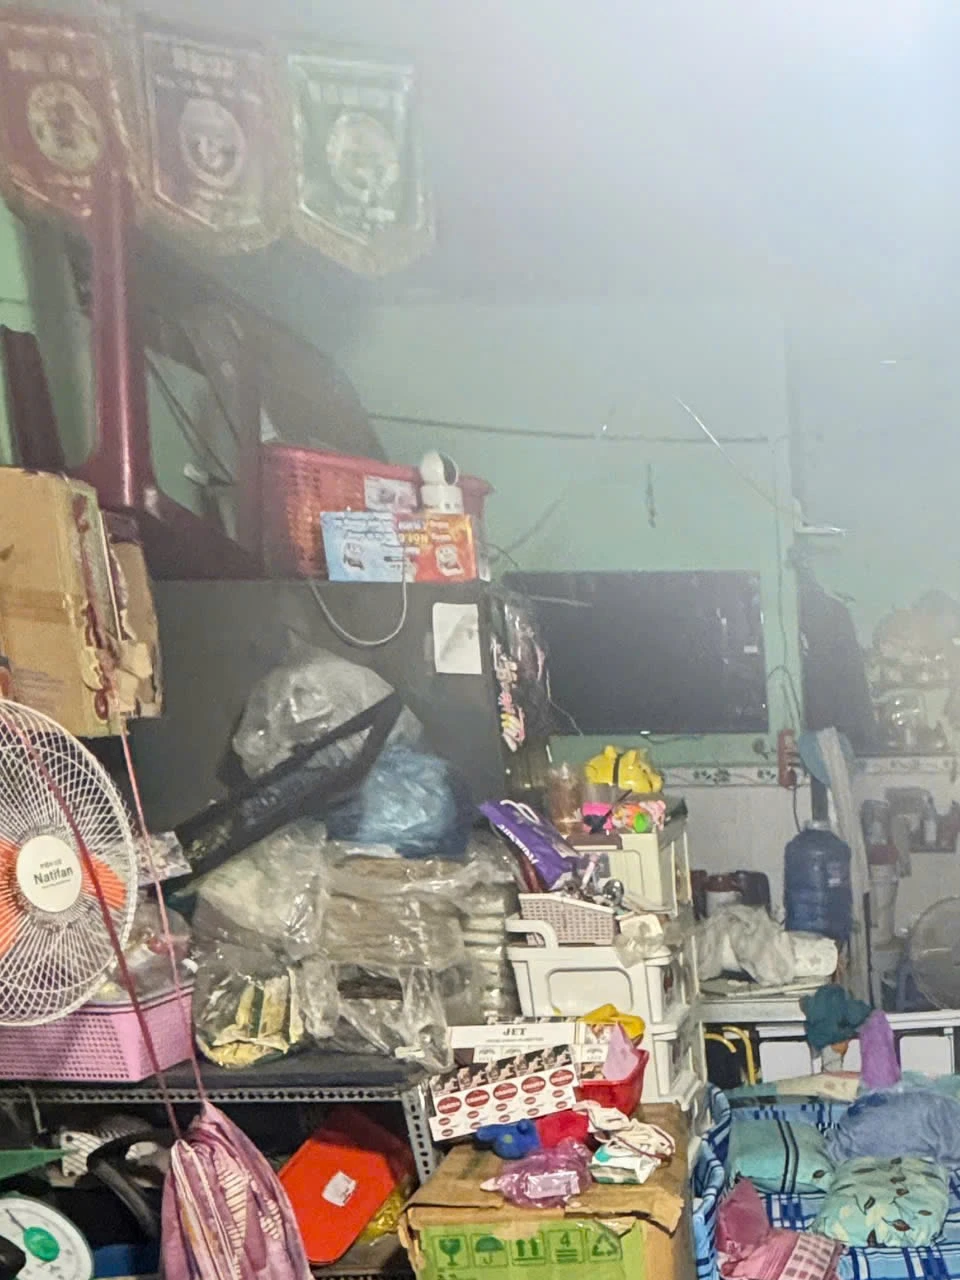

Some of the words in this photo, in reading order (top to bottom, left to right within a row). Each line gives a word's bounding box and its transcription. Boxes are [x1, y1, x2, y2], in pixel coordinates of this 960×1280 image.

[33, 866, 74, 885] Natifan
[502, 1027, 527, 1037] JET
[559, 1231, 571, 1248] 4
